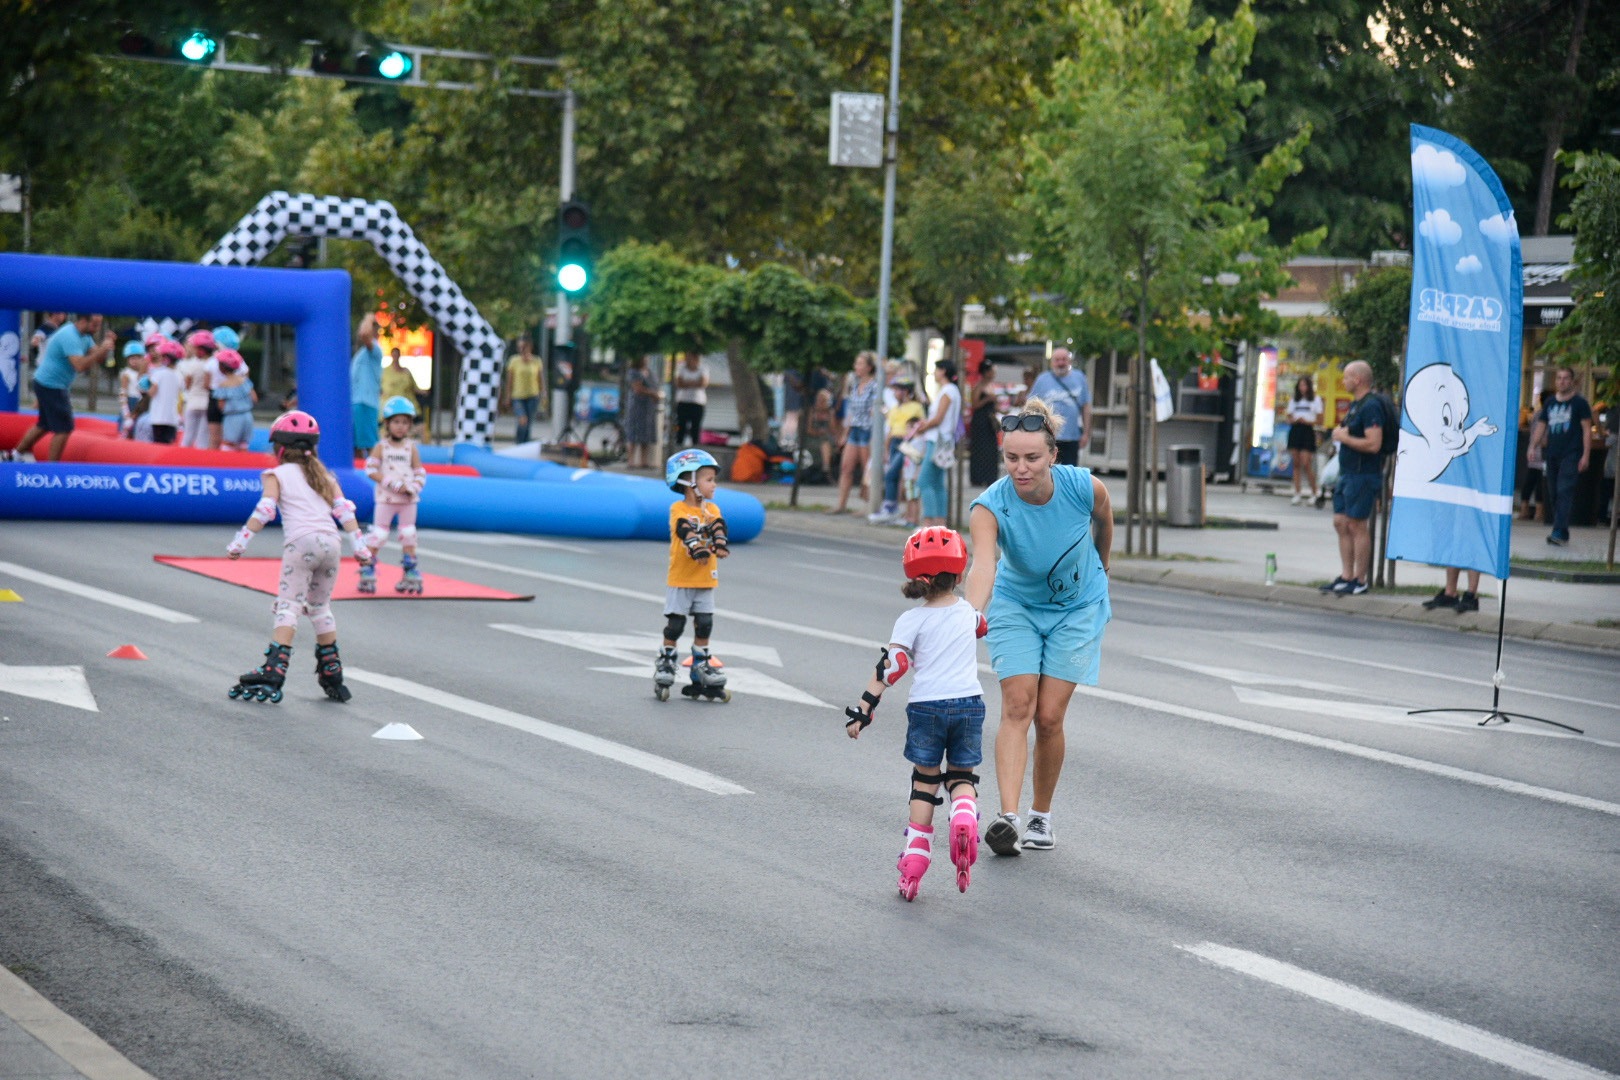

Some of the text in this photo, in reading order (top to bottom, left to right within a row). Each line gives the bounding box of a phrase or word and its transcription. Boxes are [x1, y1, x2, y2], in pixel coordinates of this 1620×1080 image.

[15, 471, 264, 496] ŠKOLA SPORTA CASPER BANJ
